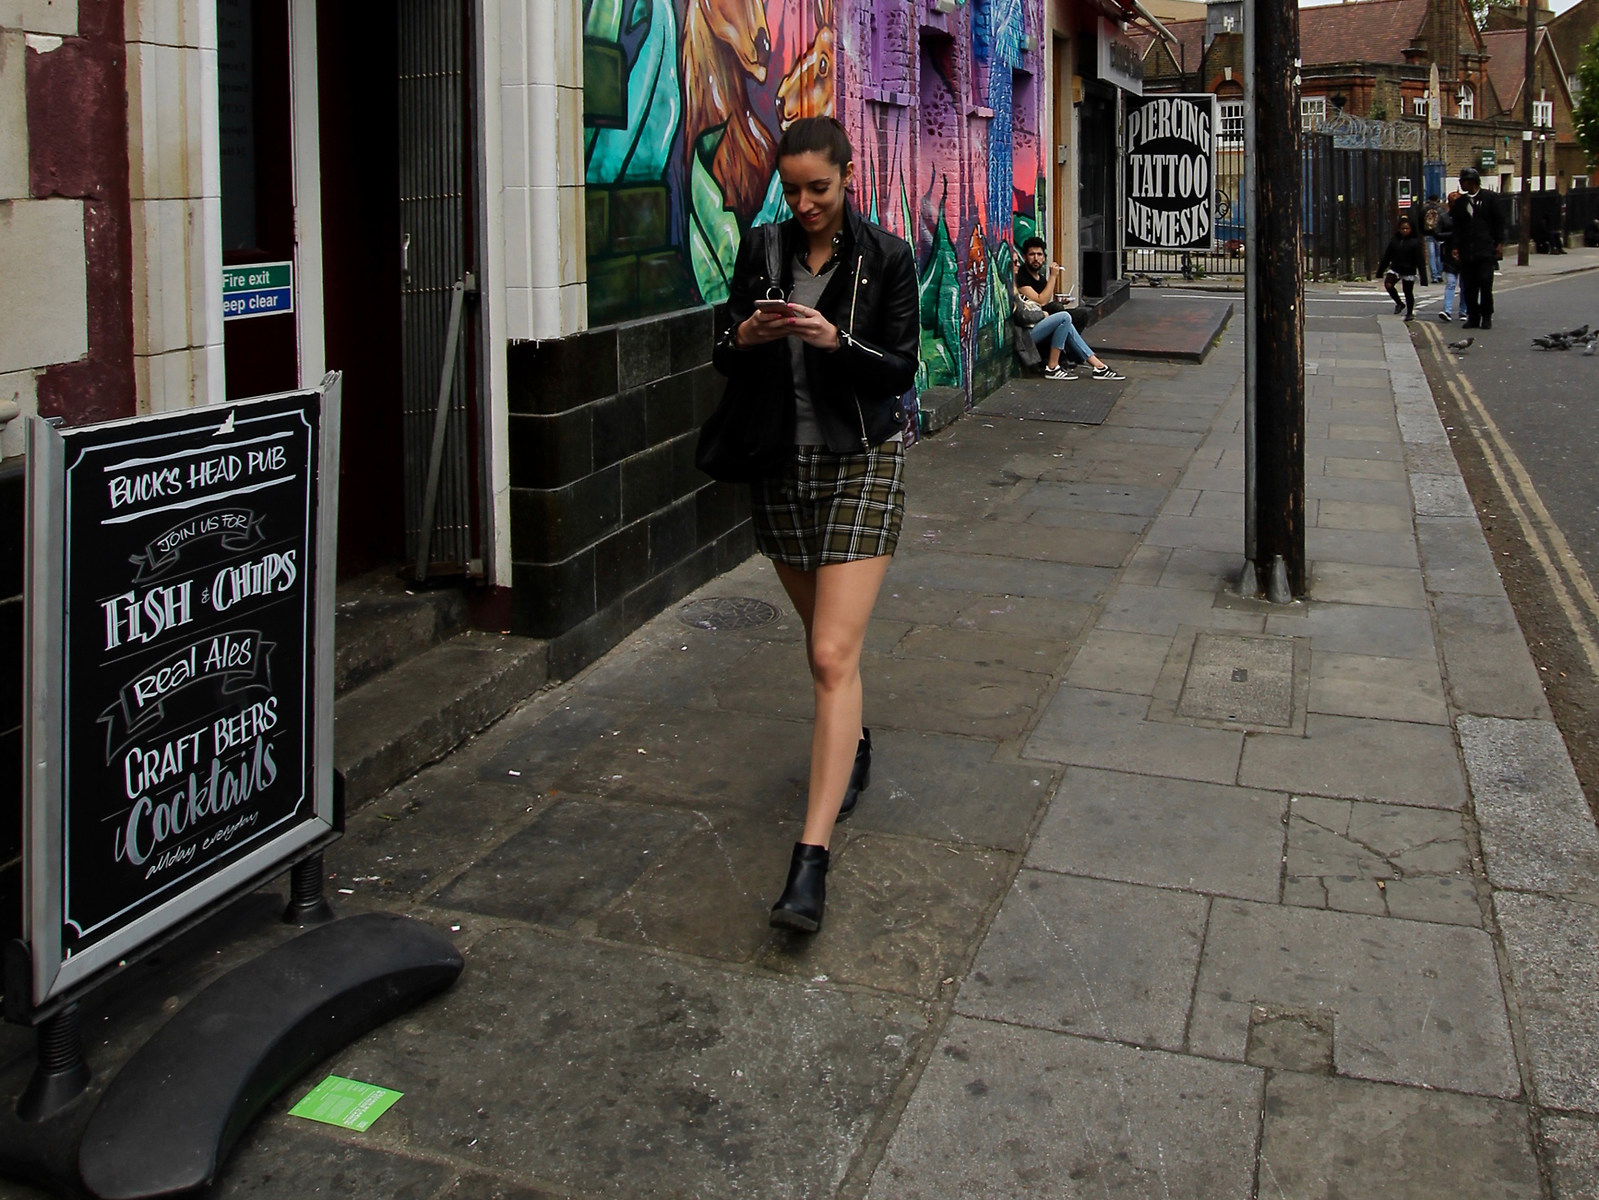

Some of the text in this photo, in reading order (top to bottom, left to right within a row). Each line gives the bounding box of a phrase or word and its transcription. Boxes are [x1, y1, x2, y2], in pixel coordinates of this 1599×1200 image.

[1128, 98, 1210, 156] PIERCING
[1130, 154, 1208, 198] TATTOO
[1128, 198, 1209, 246] NEMESIS
[223, 270, 270, 288] Fire exit
[224, 294, 279, 314] eep clear
[108, 446, 287, 509] BUCK'S HEAD PUB
[157, 514, 248, 552] JOIN US FOR
[101, 550, 297, 651] FISH & CHIPS
[133, 635, 252, 708] Real Ales
[125, 696, 278, 799] CRAFT BEERS
[115, 735, 278, 866] Cocktails
[202, 810, 259, 850] everyday
